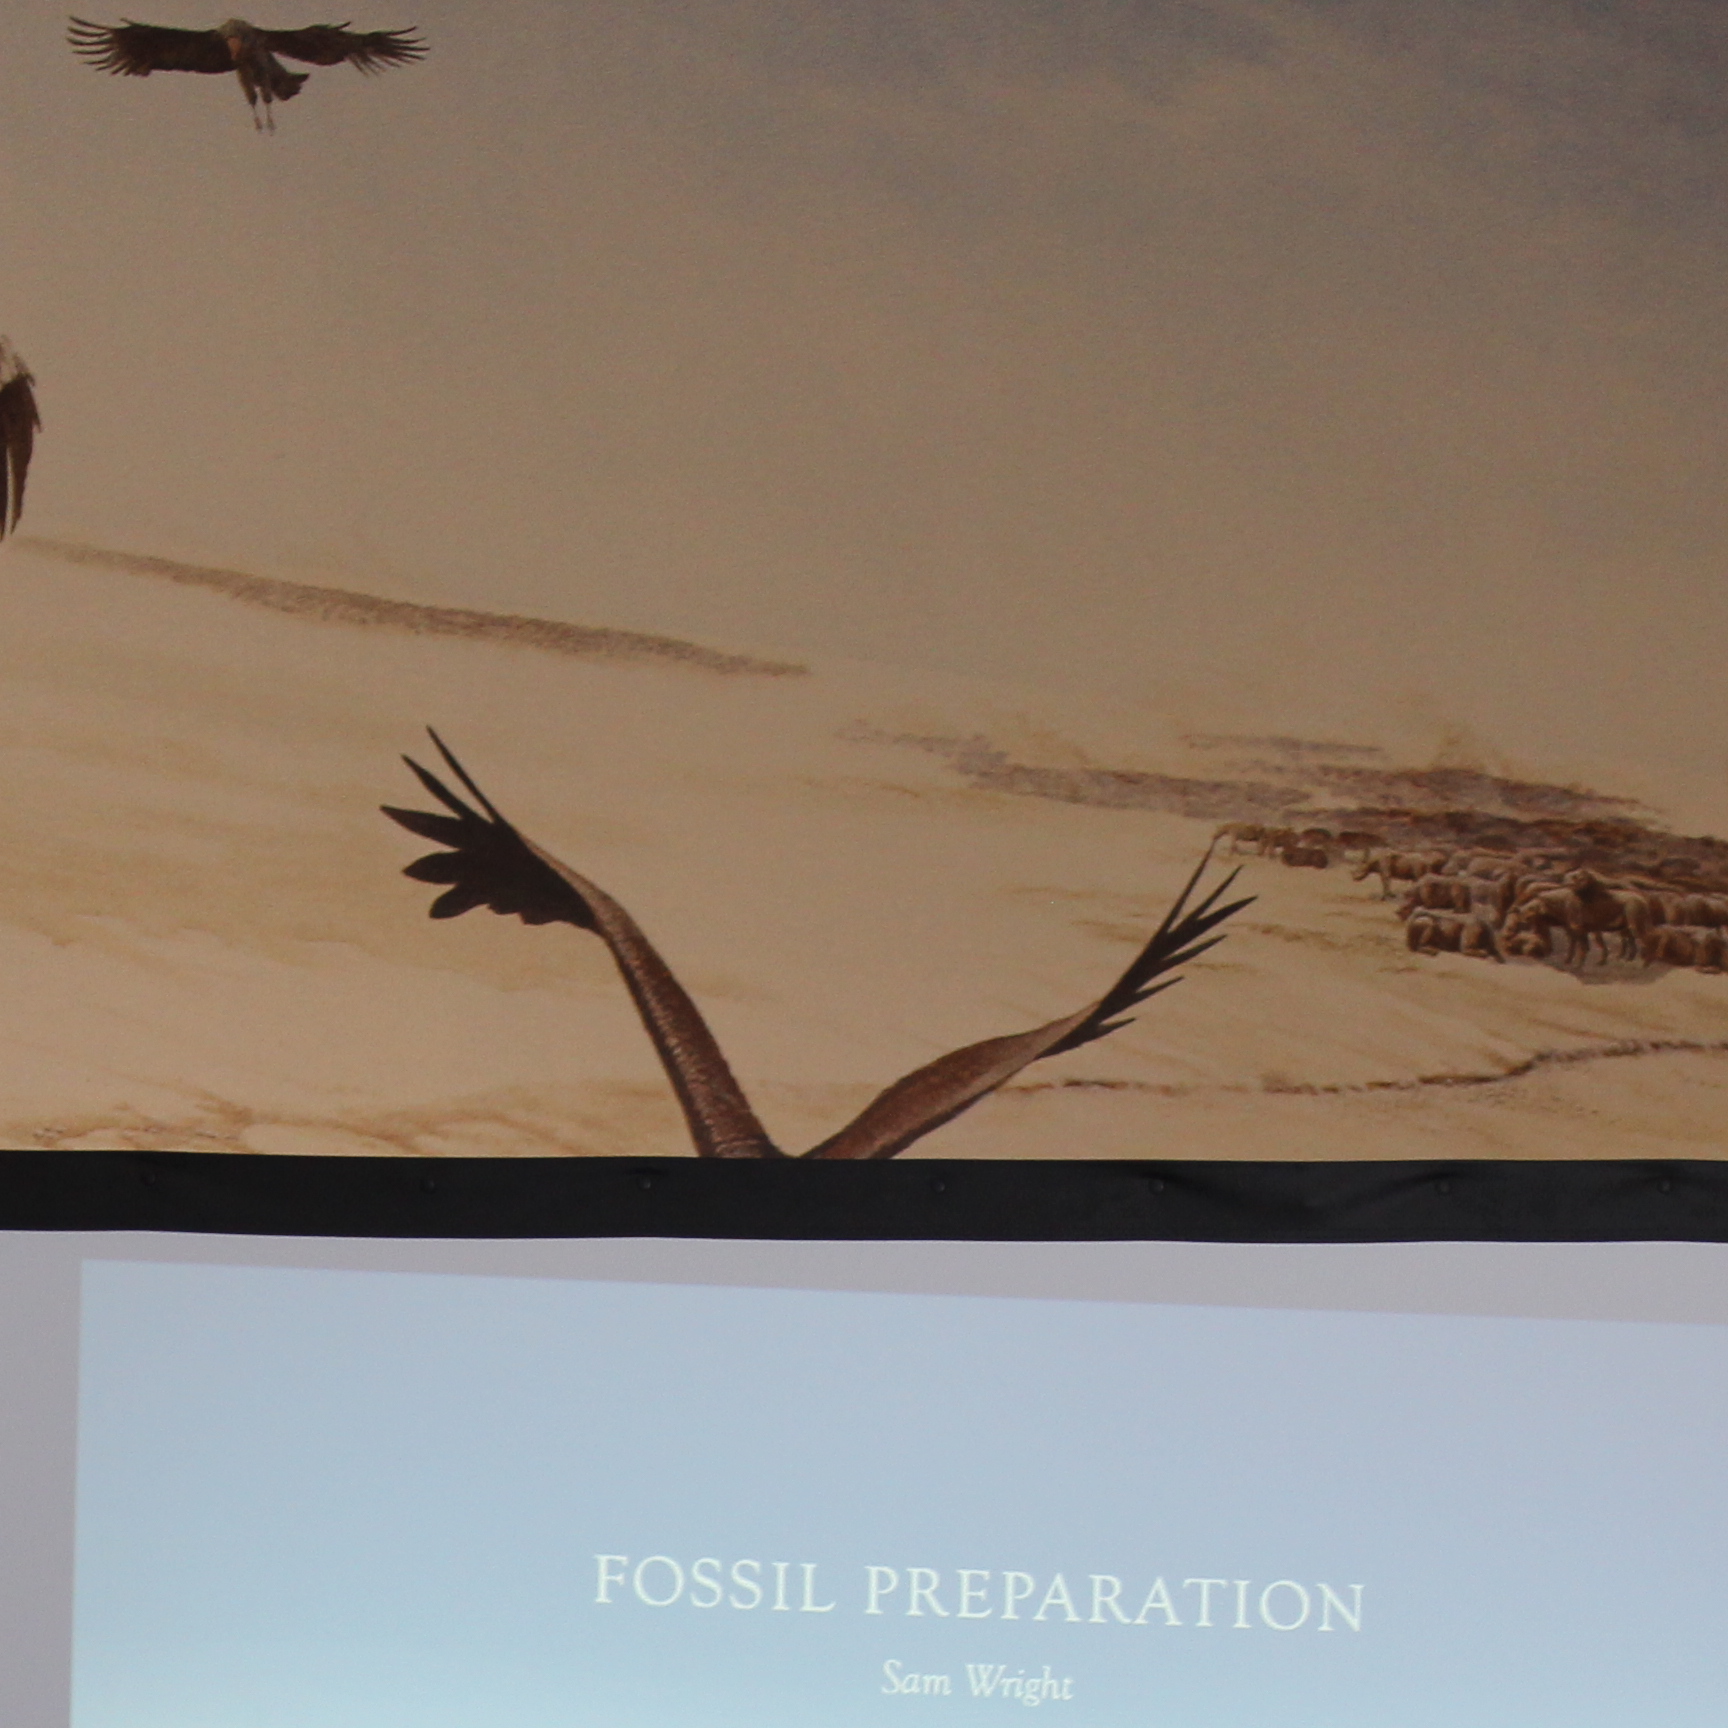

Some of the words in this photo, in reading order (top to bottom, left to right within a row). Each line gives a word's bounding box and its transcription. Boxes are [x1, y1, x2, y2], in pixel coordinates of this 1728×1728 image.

[594, 1554, 837, 1613] FOSSIL
[863, 1565, 1366, 1633] PREPARATION
[880, 1658, 952, 1696] Sam
[965, 1662, 1074, 1707] Wright
